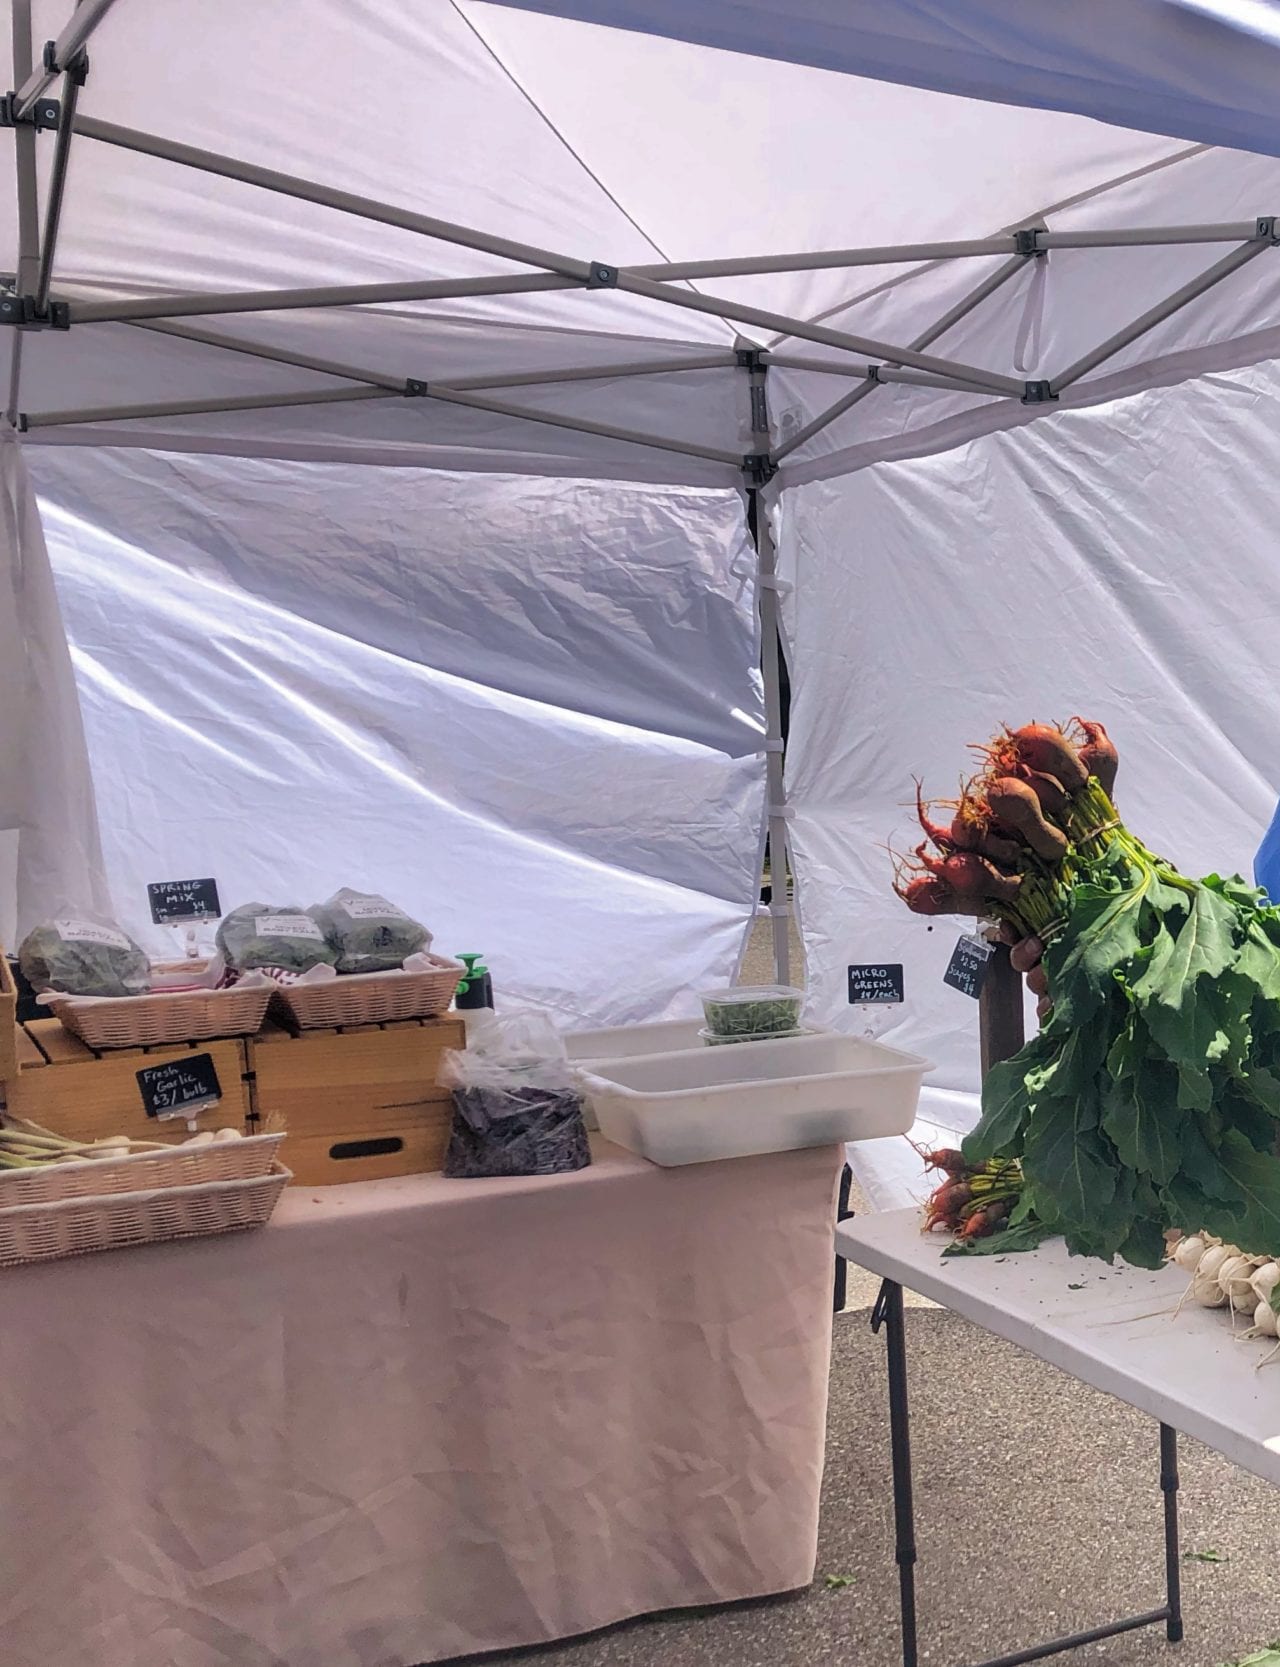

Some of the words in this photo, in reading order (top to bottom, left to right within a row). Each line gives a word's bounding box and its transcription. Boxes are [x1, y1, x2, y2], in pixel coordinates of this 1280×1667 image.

[851, 968, 887, 979] MICRO
[854, 979, 893, 989] GREENS
[143, 1066, 178, 1083] Fresh
[157, 1073, 197, 1092] Garlic
